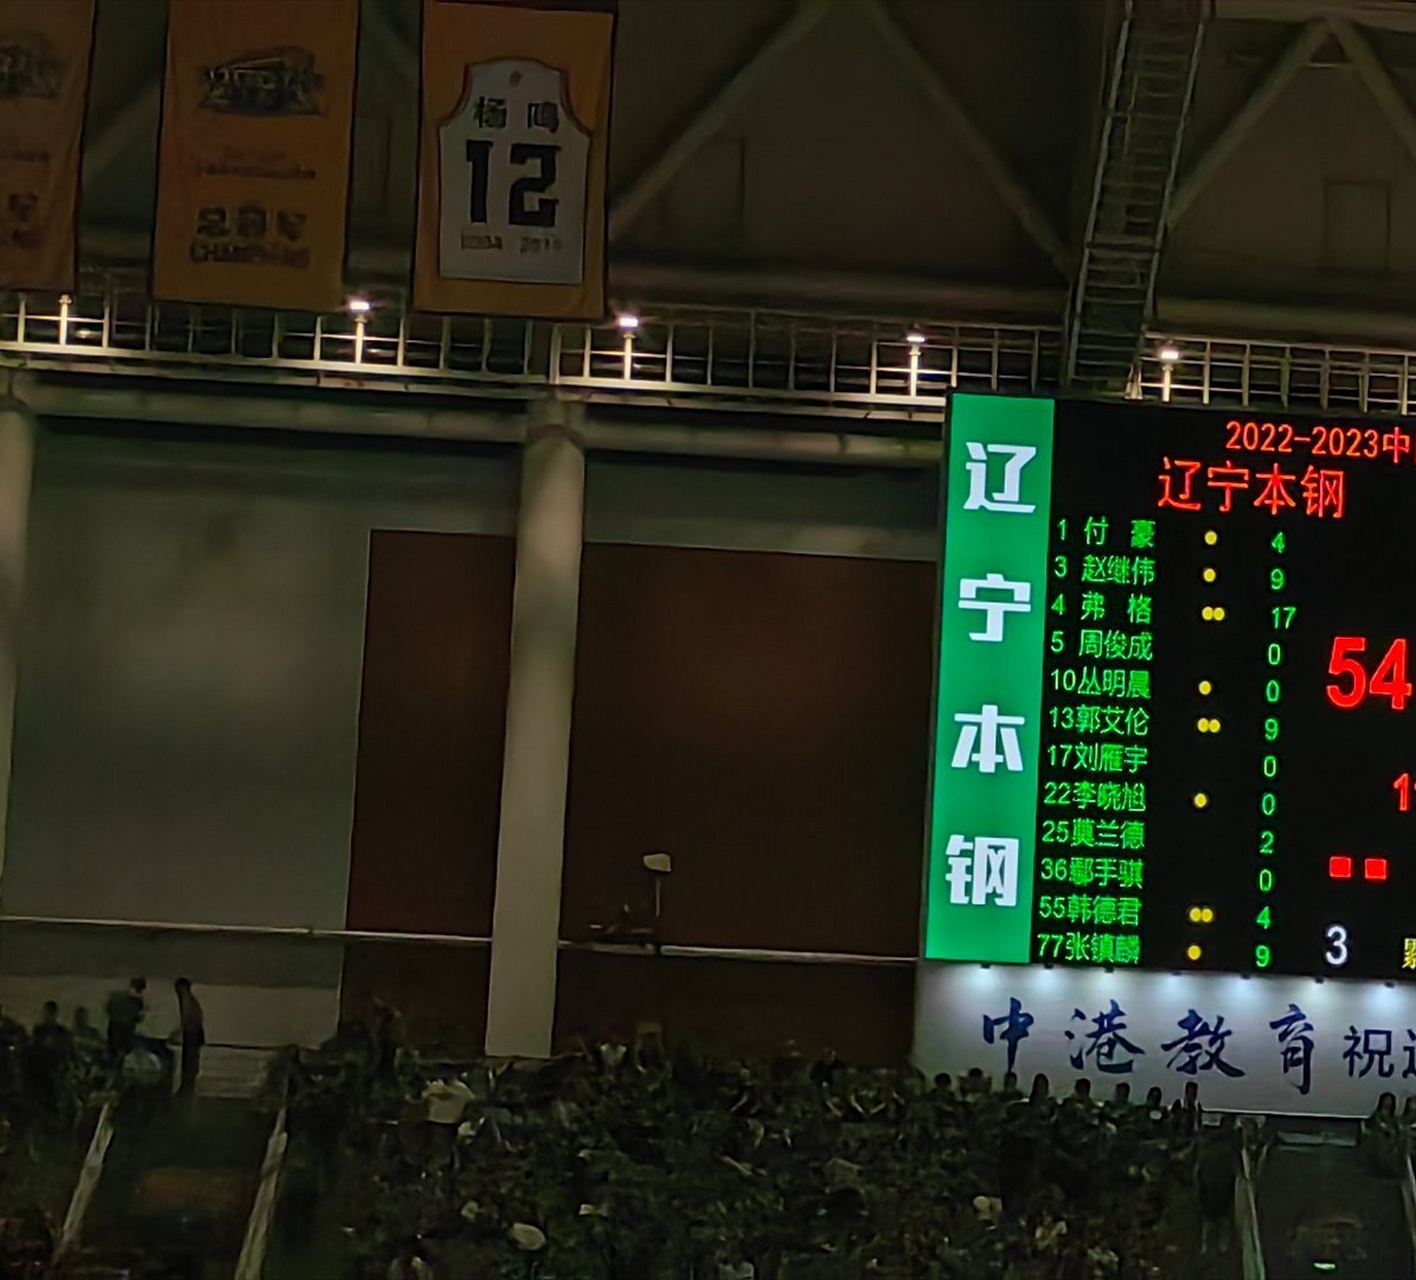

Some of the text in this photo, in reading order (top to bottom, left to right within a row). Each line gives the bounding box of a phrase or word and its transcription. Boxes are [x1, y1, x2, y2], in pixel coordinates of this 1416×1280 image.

[466, 140, 562, 226] 12
[1157, 456, 1345, 519] 辽宁本钢
[1057, 518, 1067, 541] 1
[1270, 531, 1286, 554] 4
[1054, 554, 1285, 590] 3 赵继伟 9
[1051, 593, 1066, 616] 4
[1271, 606, 1297, 630] 17
[1050, 628, 1282, 666] 5 周俊成 0
[945, 441, 1037, 908] 辽宁本钢
[1265, 679, 1280, 703] 0
[1326, 635, 1414, 711] 54
[1264, 717, 1279, 742] 9
[1263, 754, 1277, 778] 0
[1261, 792, 1276, 817] 0
[1259, 830, 1274, 854] 2
[1258, 868, 1273, 892] 0
[1255, 905, 1272, 930] 4
[1255, 944, 1271, 968] 9
[1325, 925, 1349, 965] 3
[982, 996, 1316, 1095] 中港教育
